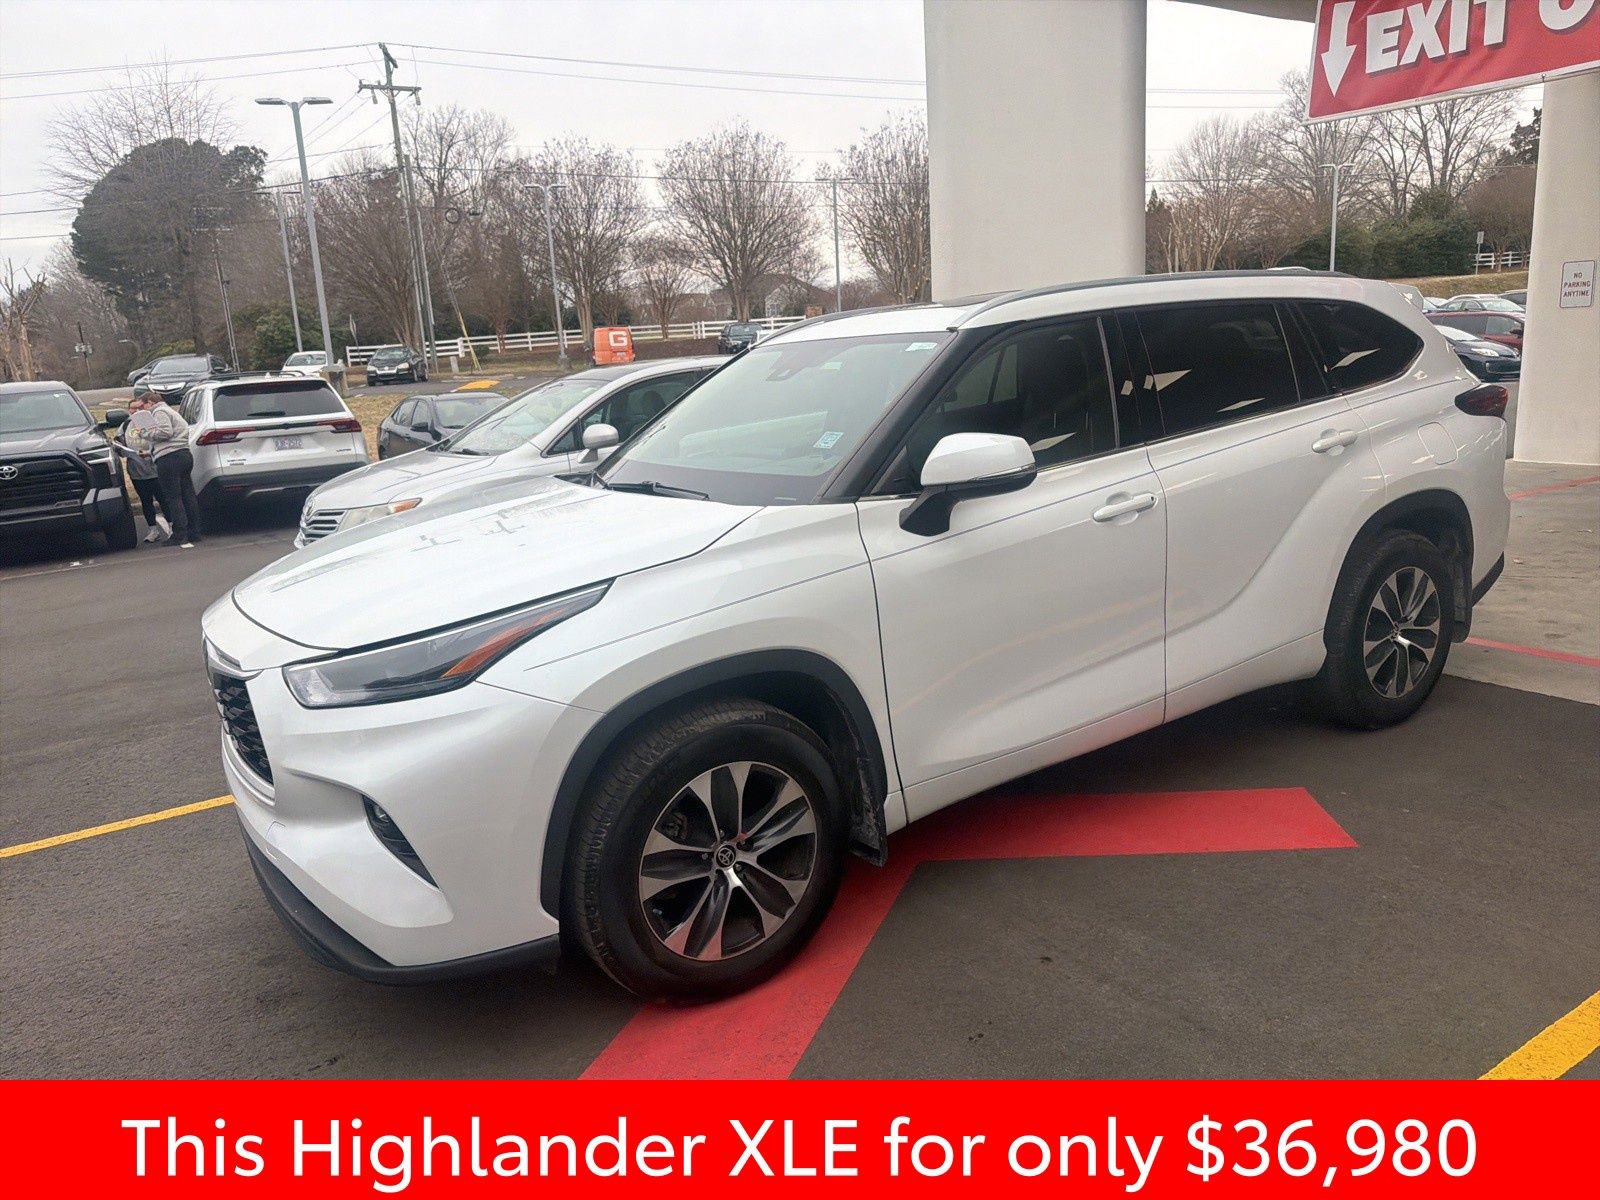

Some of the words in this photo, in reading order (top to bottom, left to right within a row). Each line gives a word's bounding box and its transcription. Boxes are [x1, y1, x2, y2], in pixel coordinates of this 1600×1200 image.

[1365, 0, 1507, 74] EXIT
[1563, 280, 1591, 288] PARKING
[608, 331, 628, 346] G
